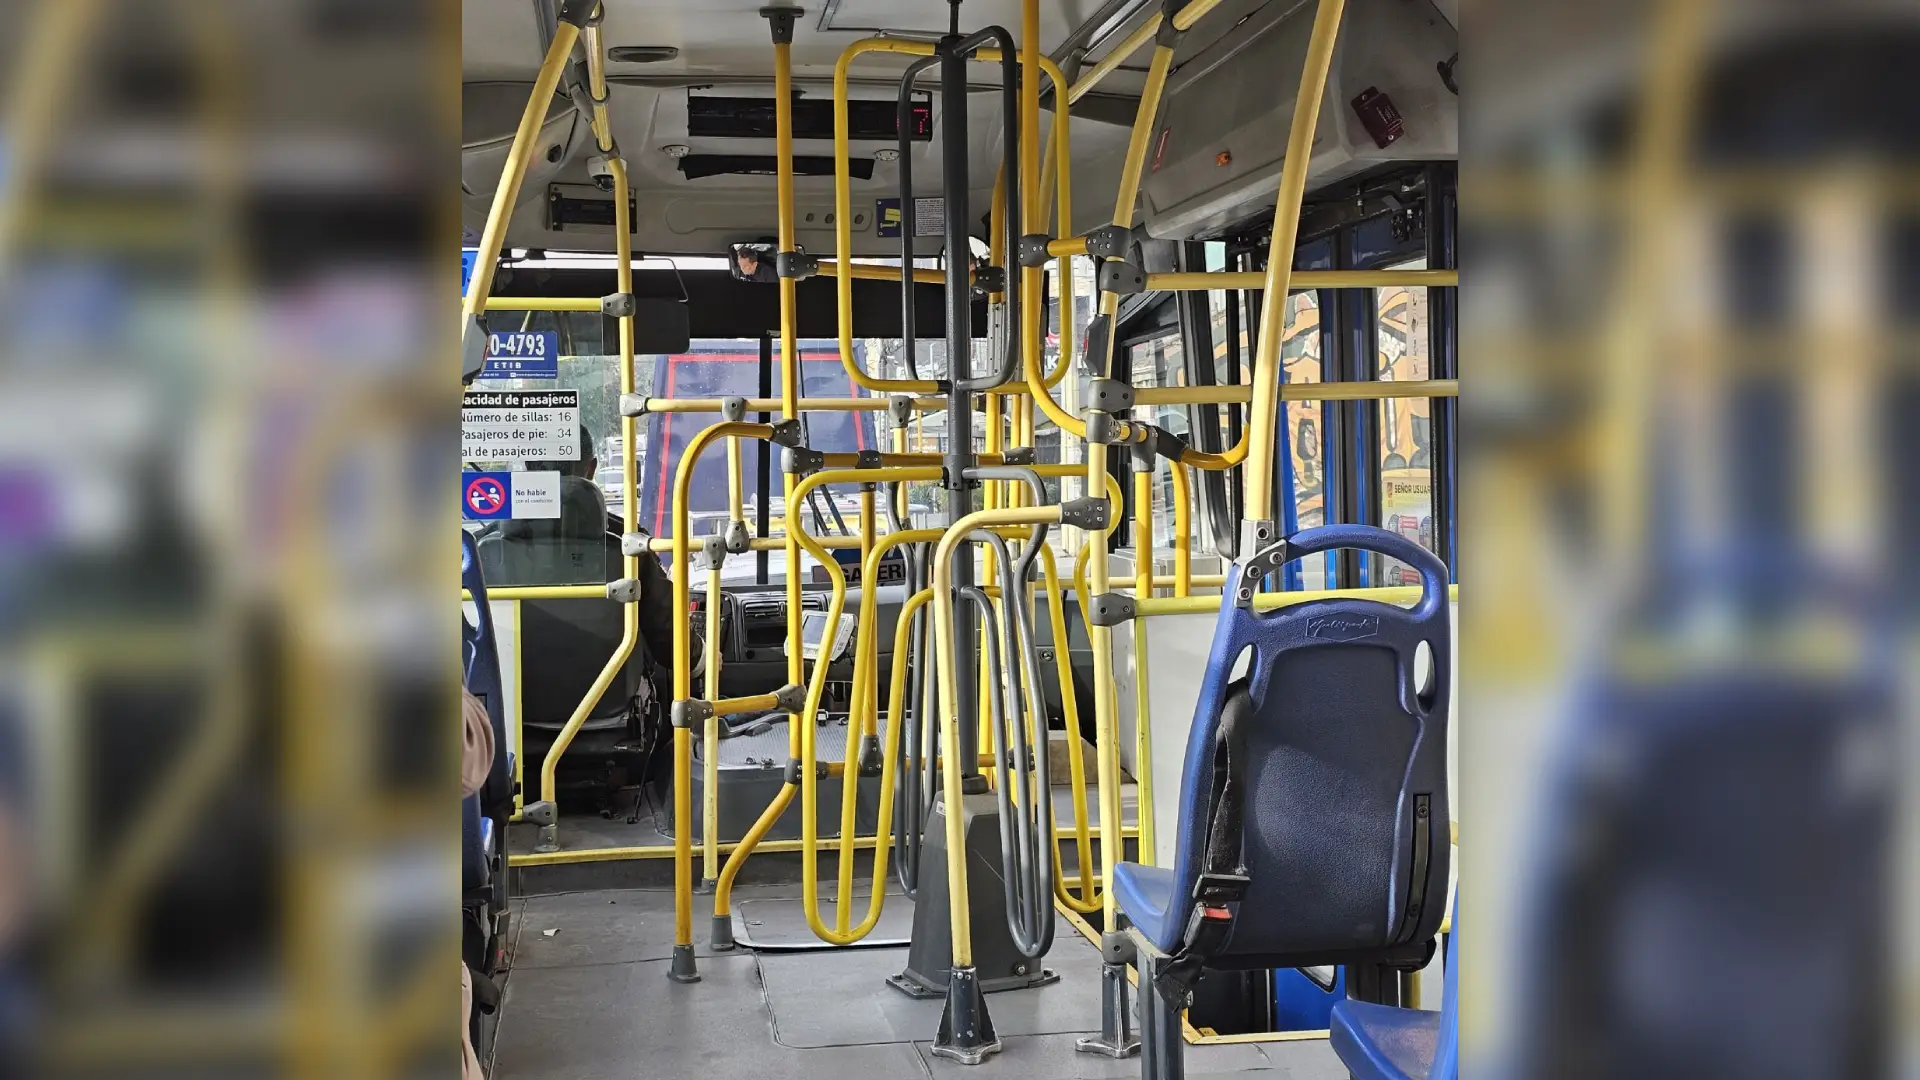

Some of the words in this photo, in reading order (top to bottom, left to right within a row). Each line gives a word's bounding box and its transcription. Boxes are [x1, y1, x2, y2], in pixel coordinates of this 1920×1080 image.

[490, 334, 545, 356] 0-4793
[463, 394, 502, 405] acidad
[505, 394, 519, 405] de
[522, 393, 576, 407] pasajeros
[504, 412, 518, 422] de
[521, 412, 552, 422] sillas:
[558, 411, 572, 422] 16
[512, 429, 525, 439] de
[528, 428, 548, 441] pie:
[557, 428, 572, 439] 34
[475, 446, 489, 456] de
[492, 446, 547, 458] pasajeros:
[558, 445, 573, 456] 50
[527, 488, 547, 496] hable
[1394, 482, 1412, 493] SEÑOR
